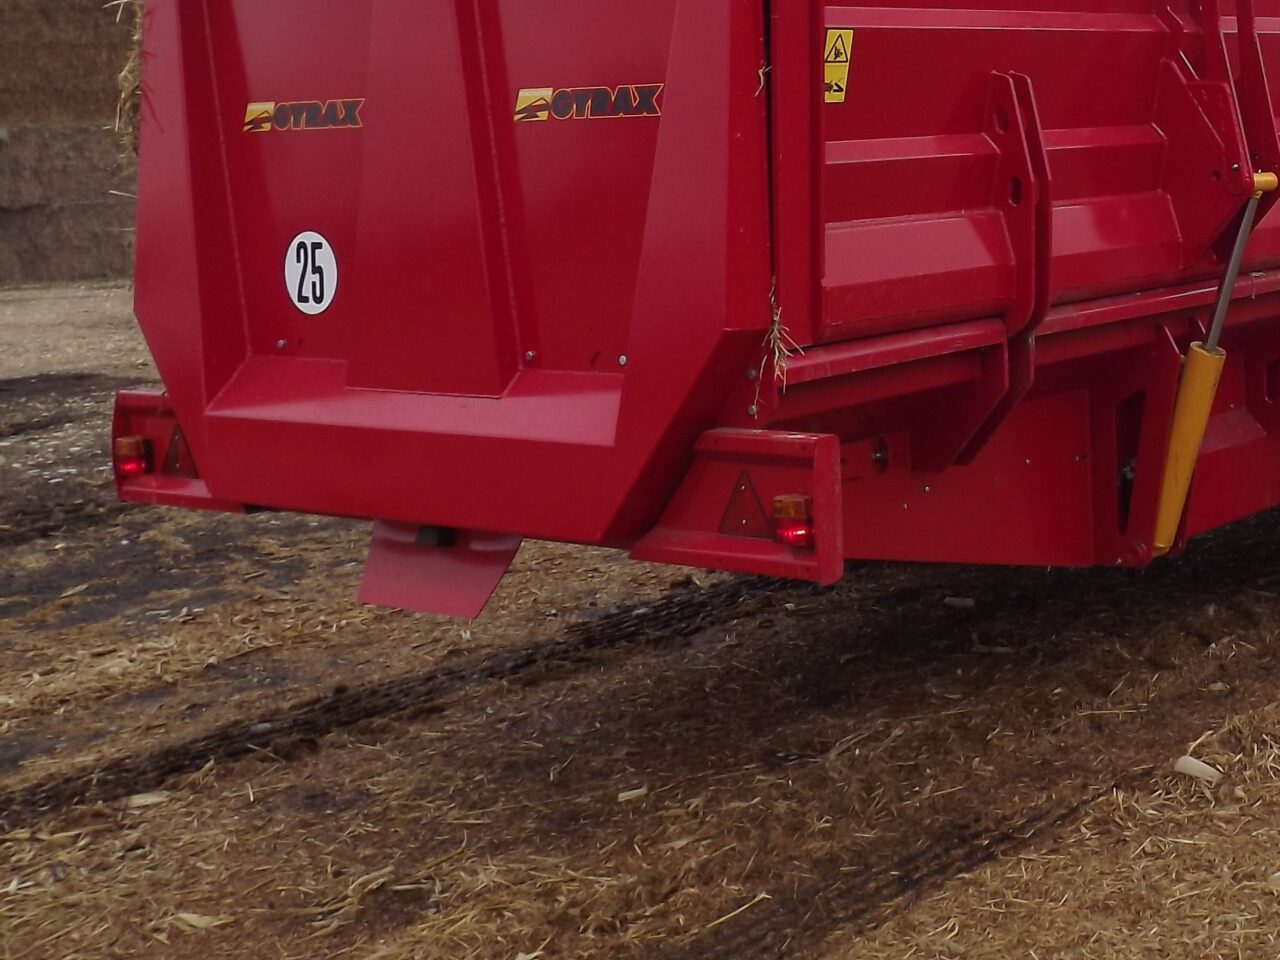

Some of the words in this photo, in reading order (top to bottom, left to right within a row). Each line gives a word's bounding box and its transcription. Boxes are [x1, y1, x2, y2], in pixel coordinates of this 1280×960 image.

[273, 98, 366, 130] GYRAX
[551, 84, 664, 119] GYRAX
[296, 241, 324, 304] 25
